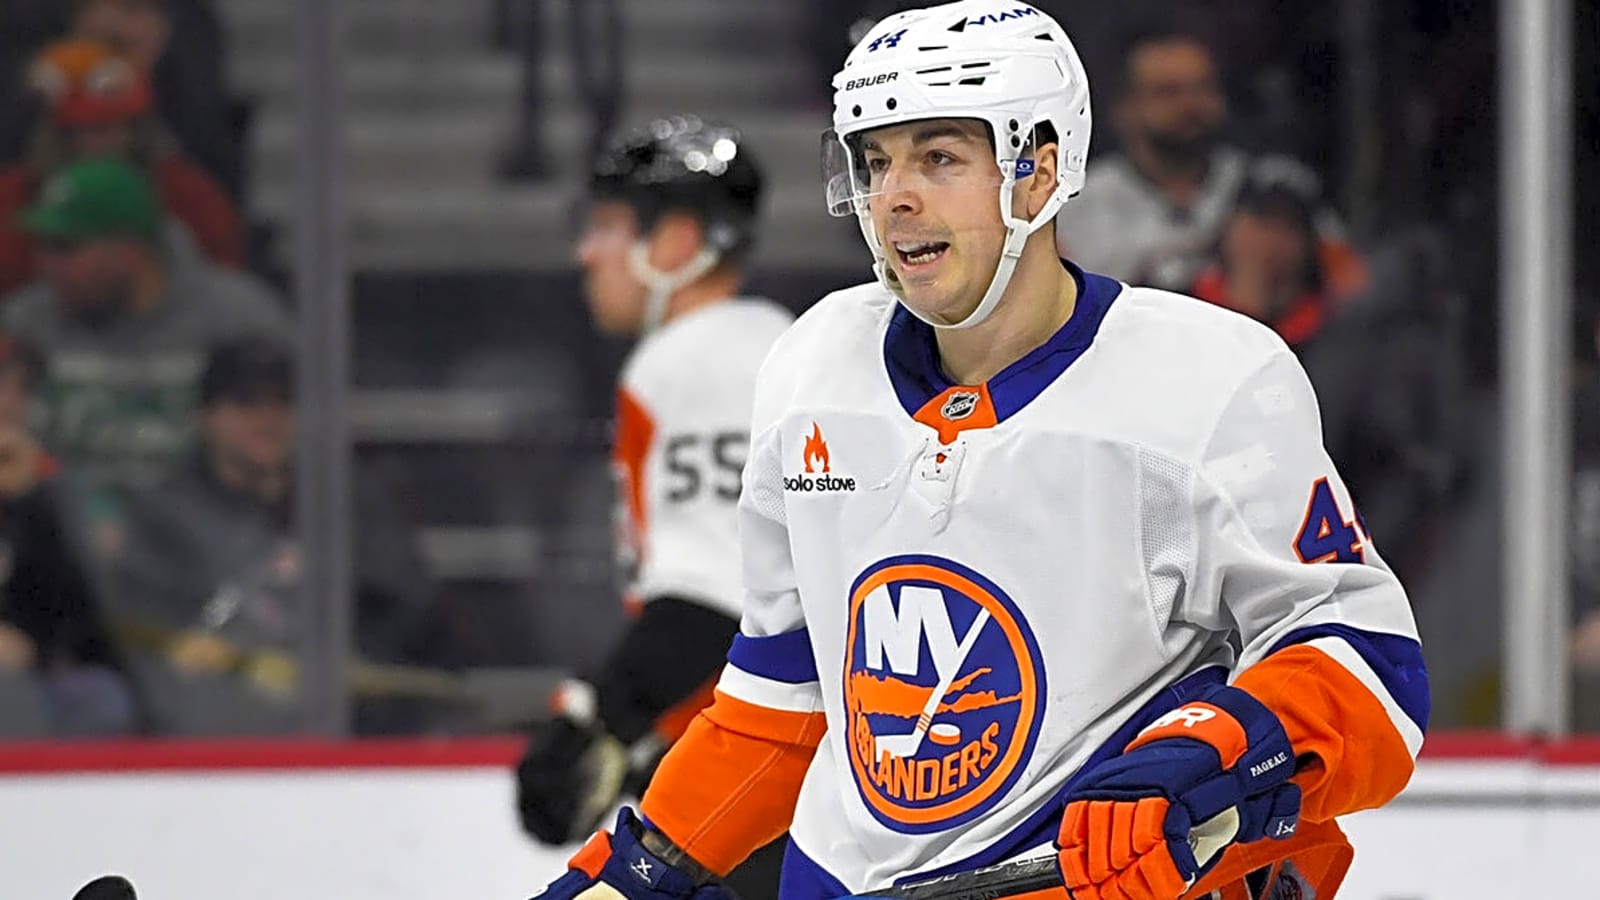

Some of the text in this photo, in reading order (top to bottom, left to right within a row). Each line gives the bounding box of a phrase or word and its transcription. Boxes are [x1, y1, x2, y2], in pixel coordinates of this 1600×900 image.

[967, 7, 1040, 26] VIAM
[845, 72, 898, 91] BAUER
[664, 433, 750, 502] 55
[783, 474, 856, 492] solo stove
[1249, 751, 1288, 777] PAGEAU
